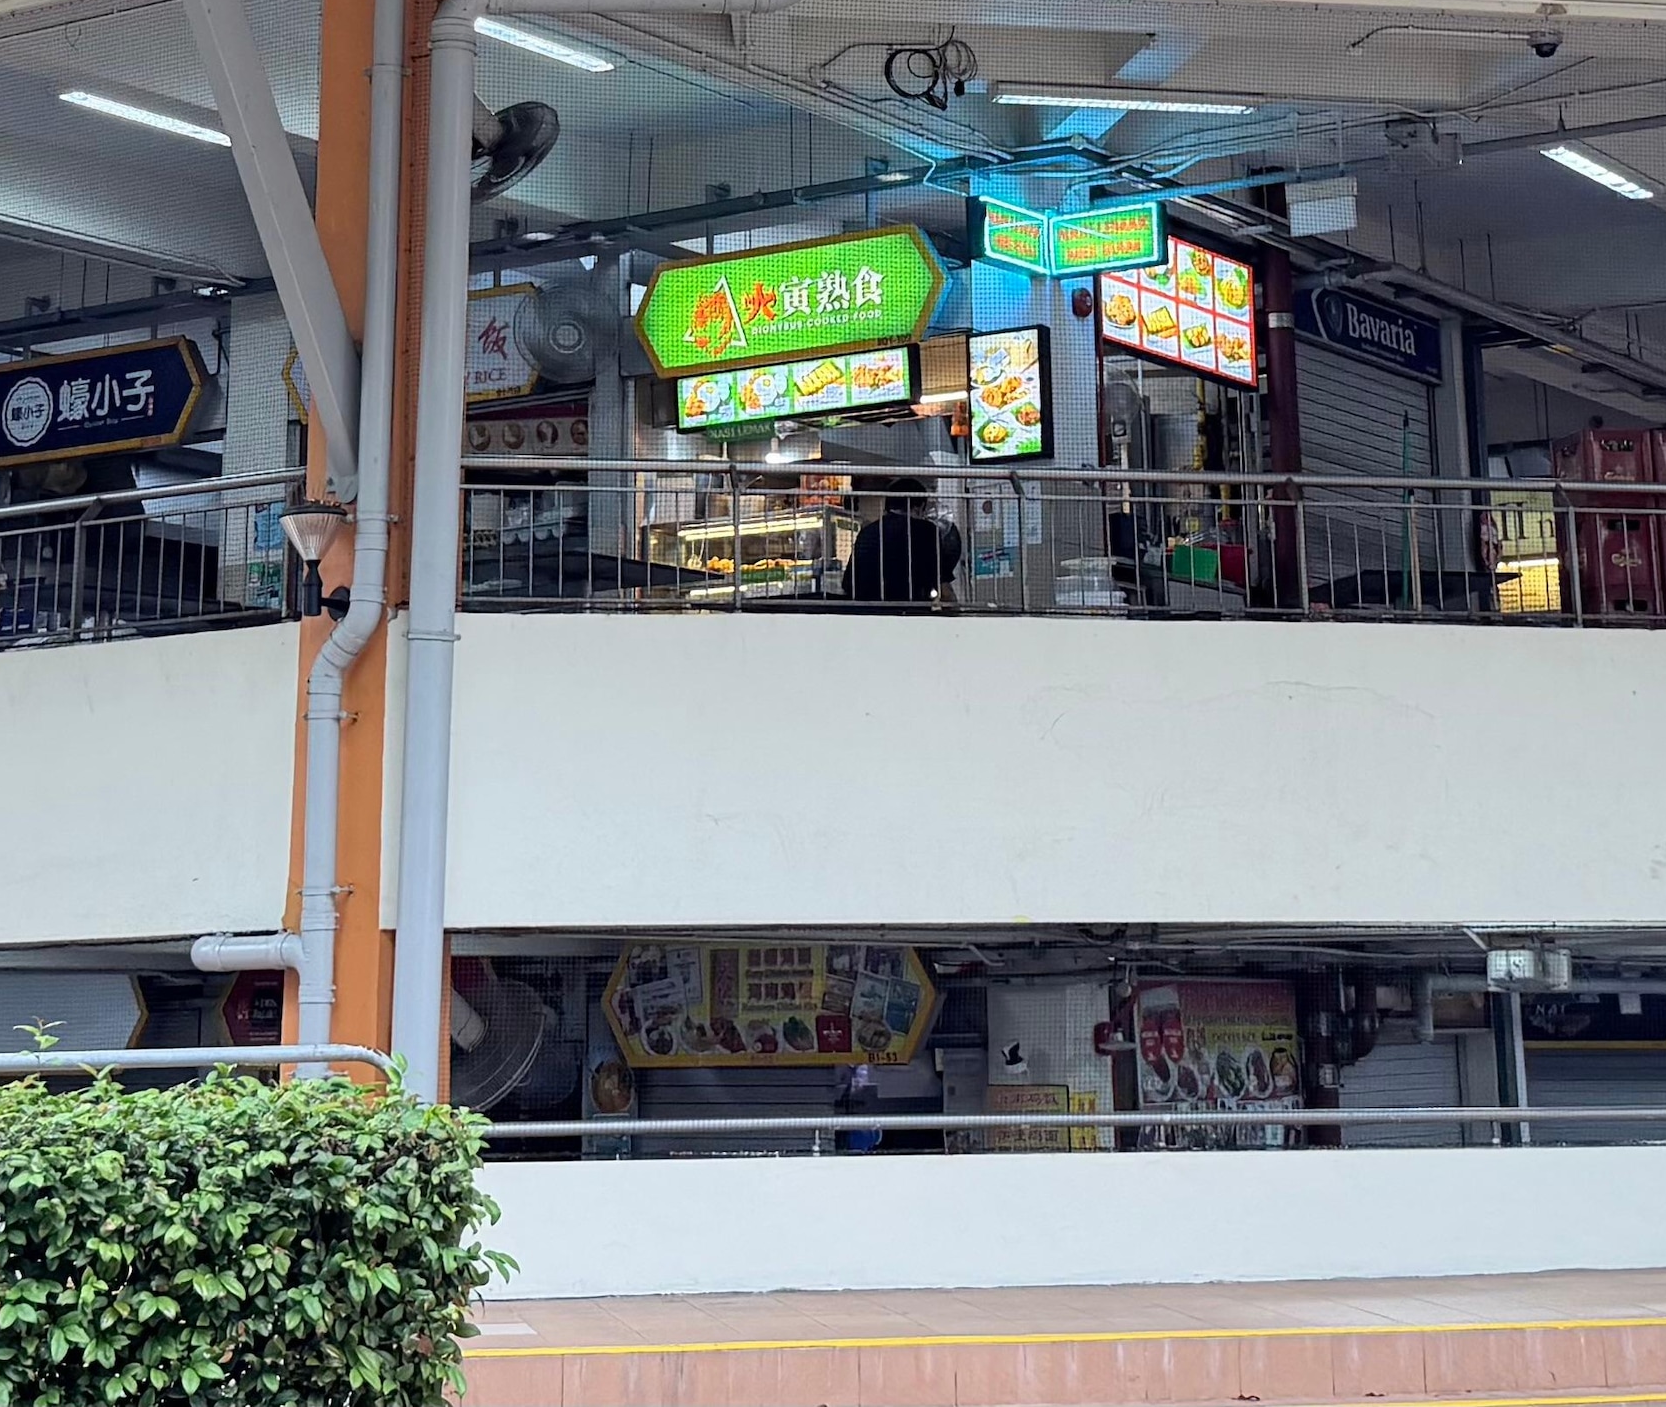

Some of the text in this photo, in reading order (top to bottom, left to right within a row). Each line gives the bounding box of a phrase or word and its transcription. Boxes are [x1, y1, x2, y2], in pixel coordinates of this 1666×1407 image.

[742, 265, 885, 324] 火寅熟食
[806, 314, 849, 328] COOKED
[852, 309, 883, 321] FOOD
[1345, 302, 1417, 357] Bavaria
[57, 369, 155, 423] 蠔小子
[474, 368, 508, 384] RICE
